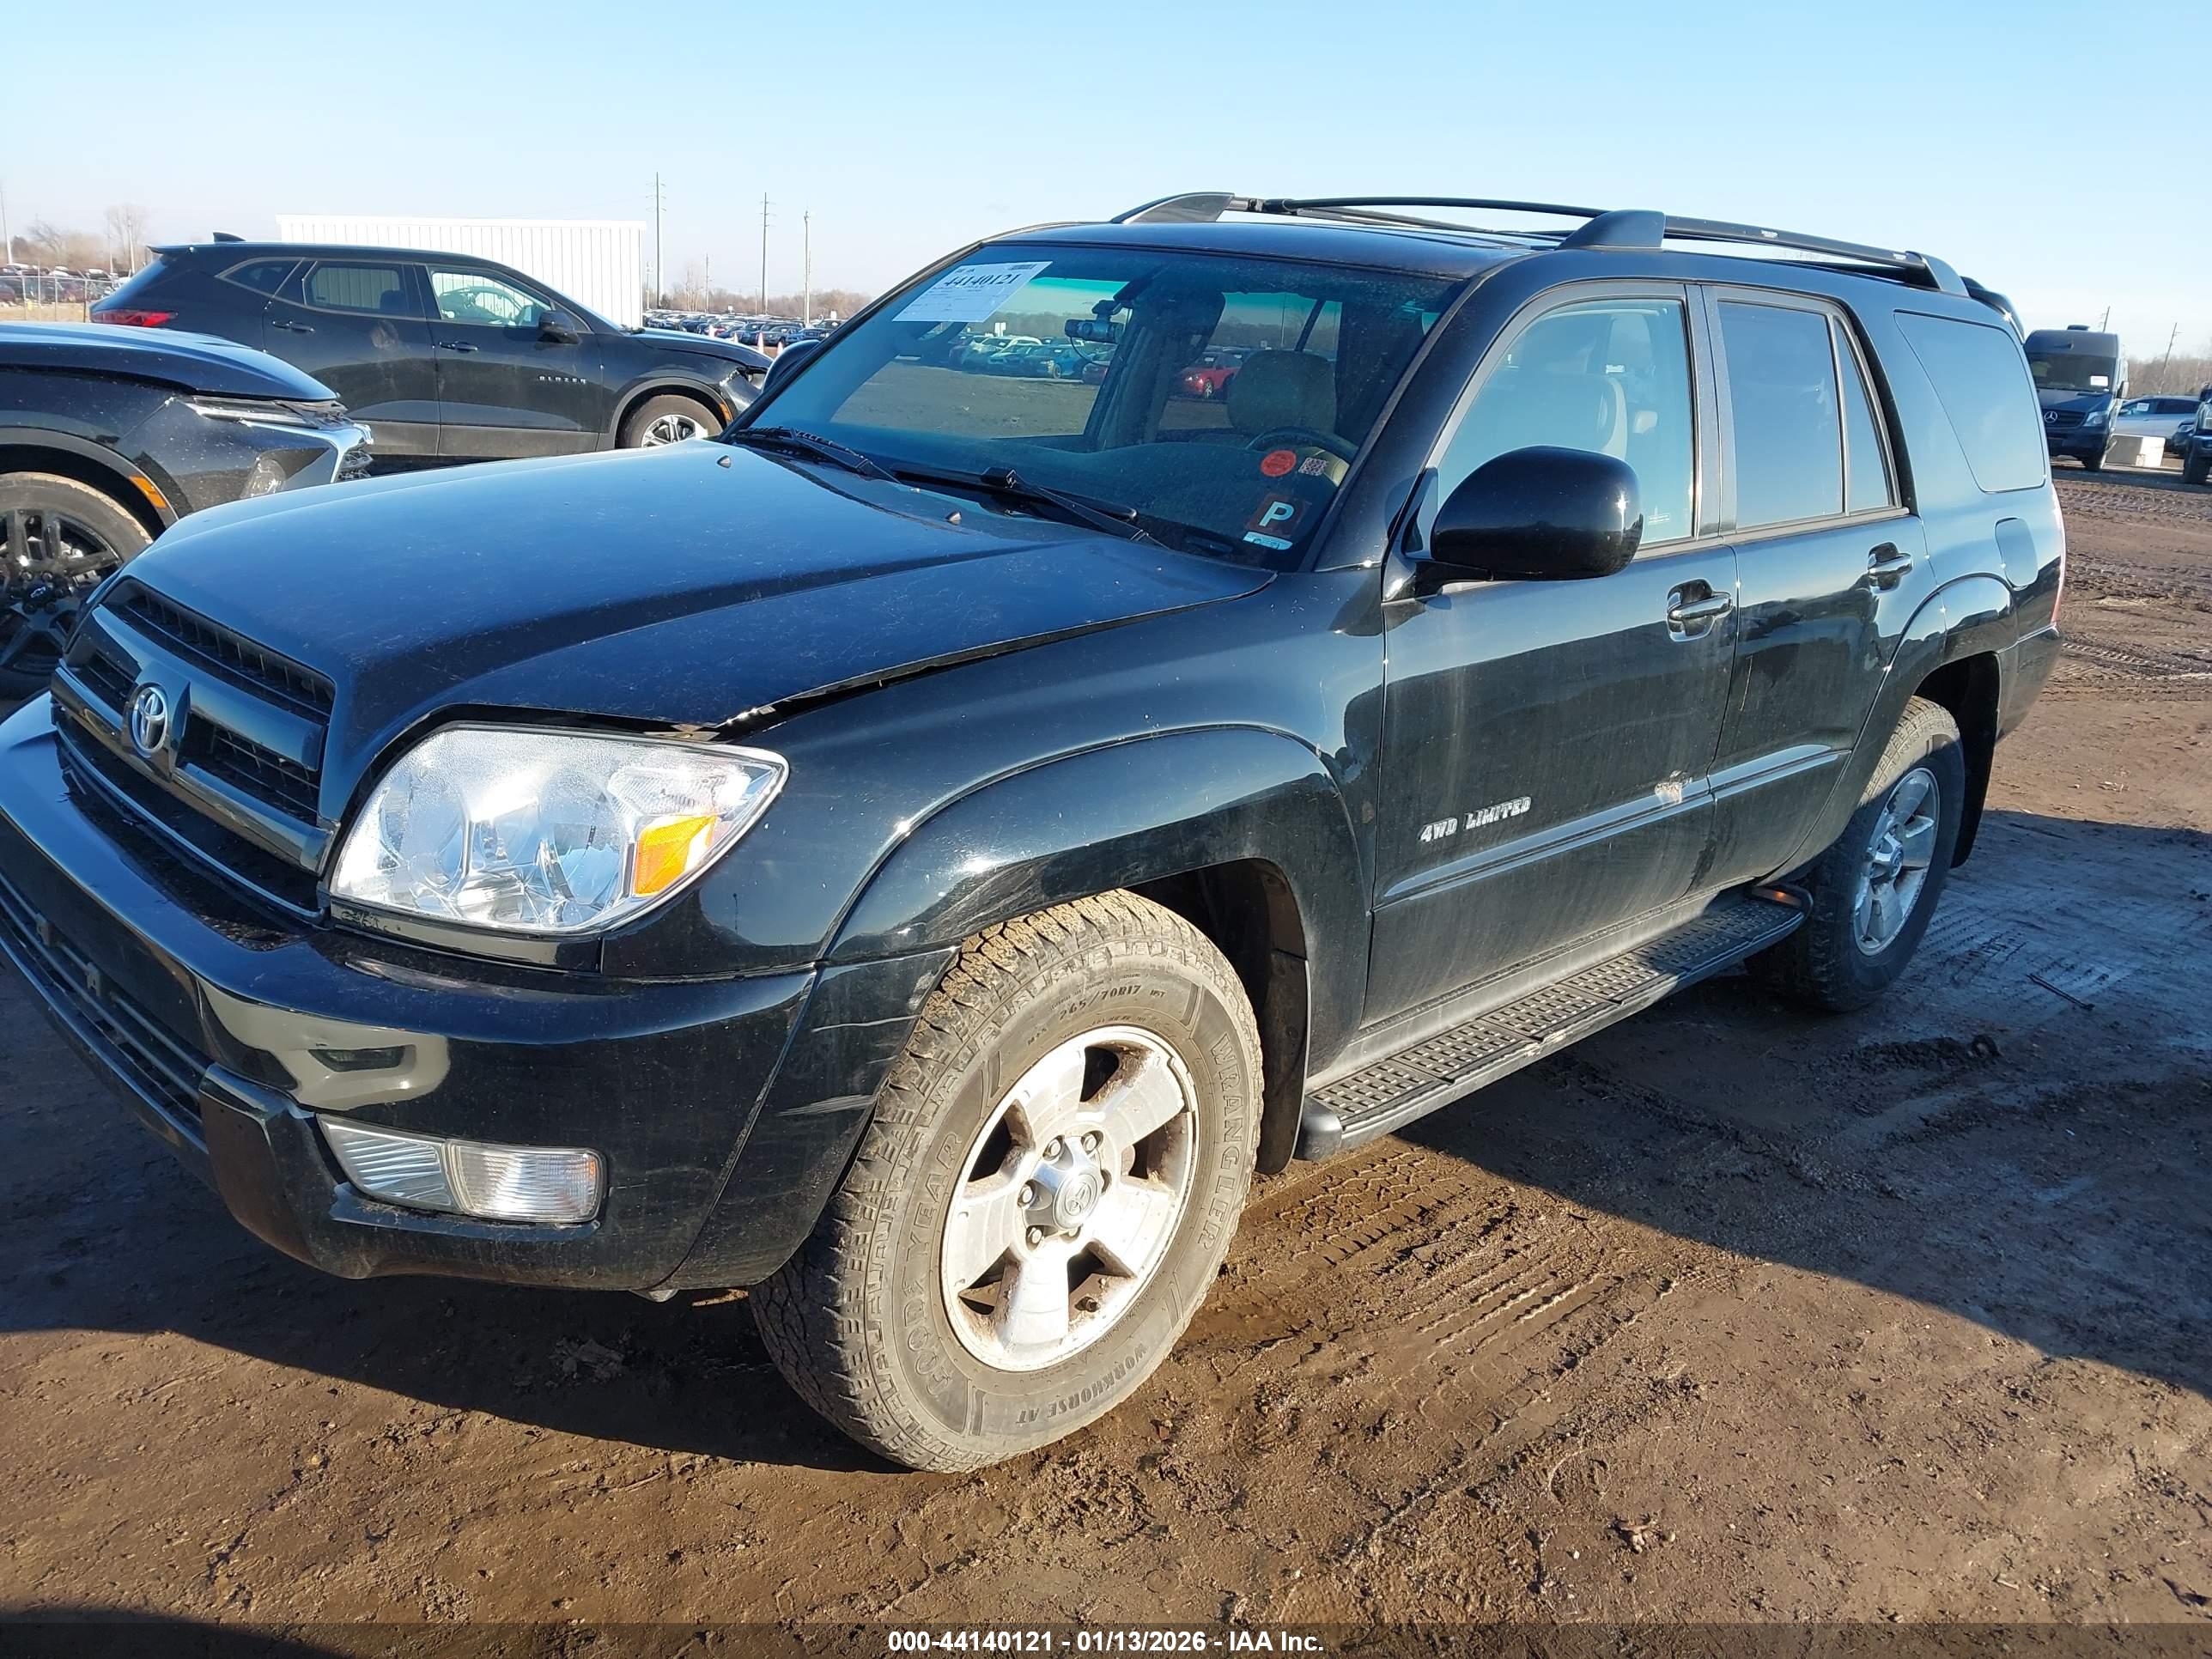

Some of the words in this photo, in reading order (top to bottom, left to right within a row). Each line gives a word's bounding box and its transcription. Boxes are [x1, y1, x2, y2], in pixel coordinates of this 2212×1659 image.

[945, 273, 1022, 287] 44140121
[538, 374, 586, 385] BLAZER
[1259, 501, 1295, 527] P
[1418, 817, 1458, 842] 4WD
[1463, 796, 1532, 830] LIMITED
[1058, 984, 1142, 1020] 265/70R17
[1198, 1032, 1244, 1250] WRANGLER
[1048, 1343, 1148, 1415] WORKHORSE
[1015, 1407, 1041, 1425] AT
